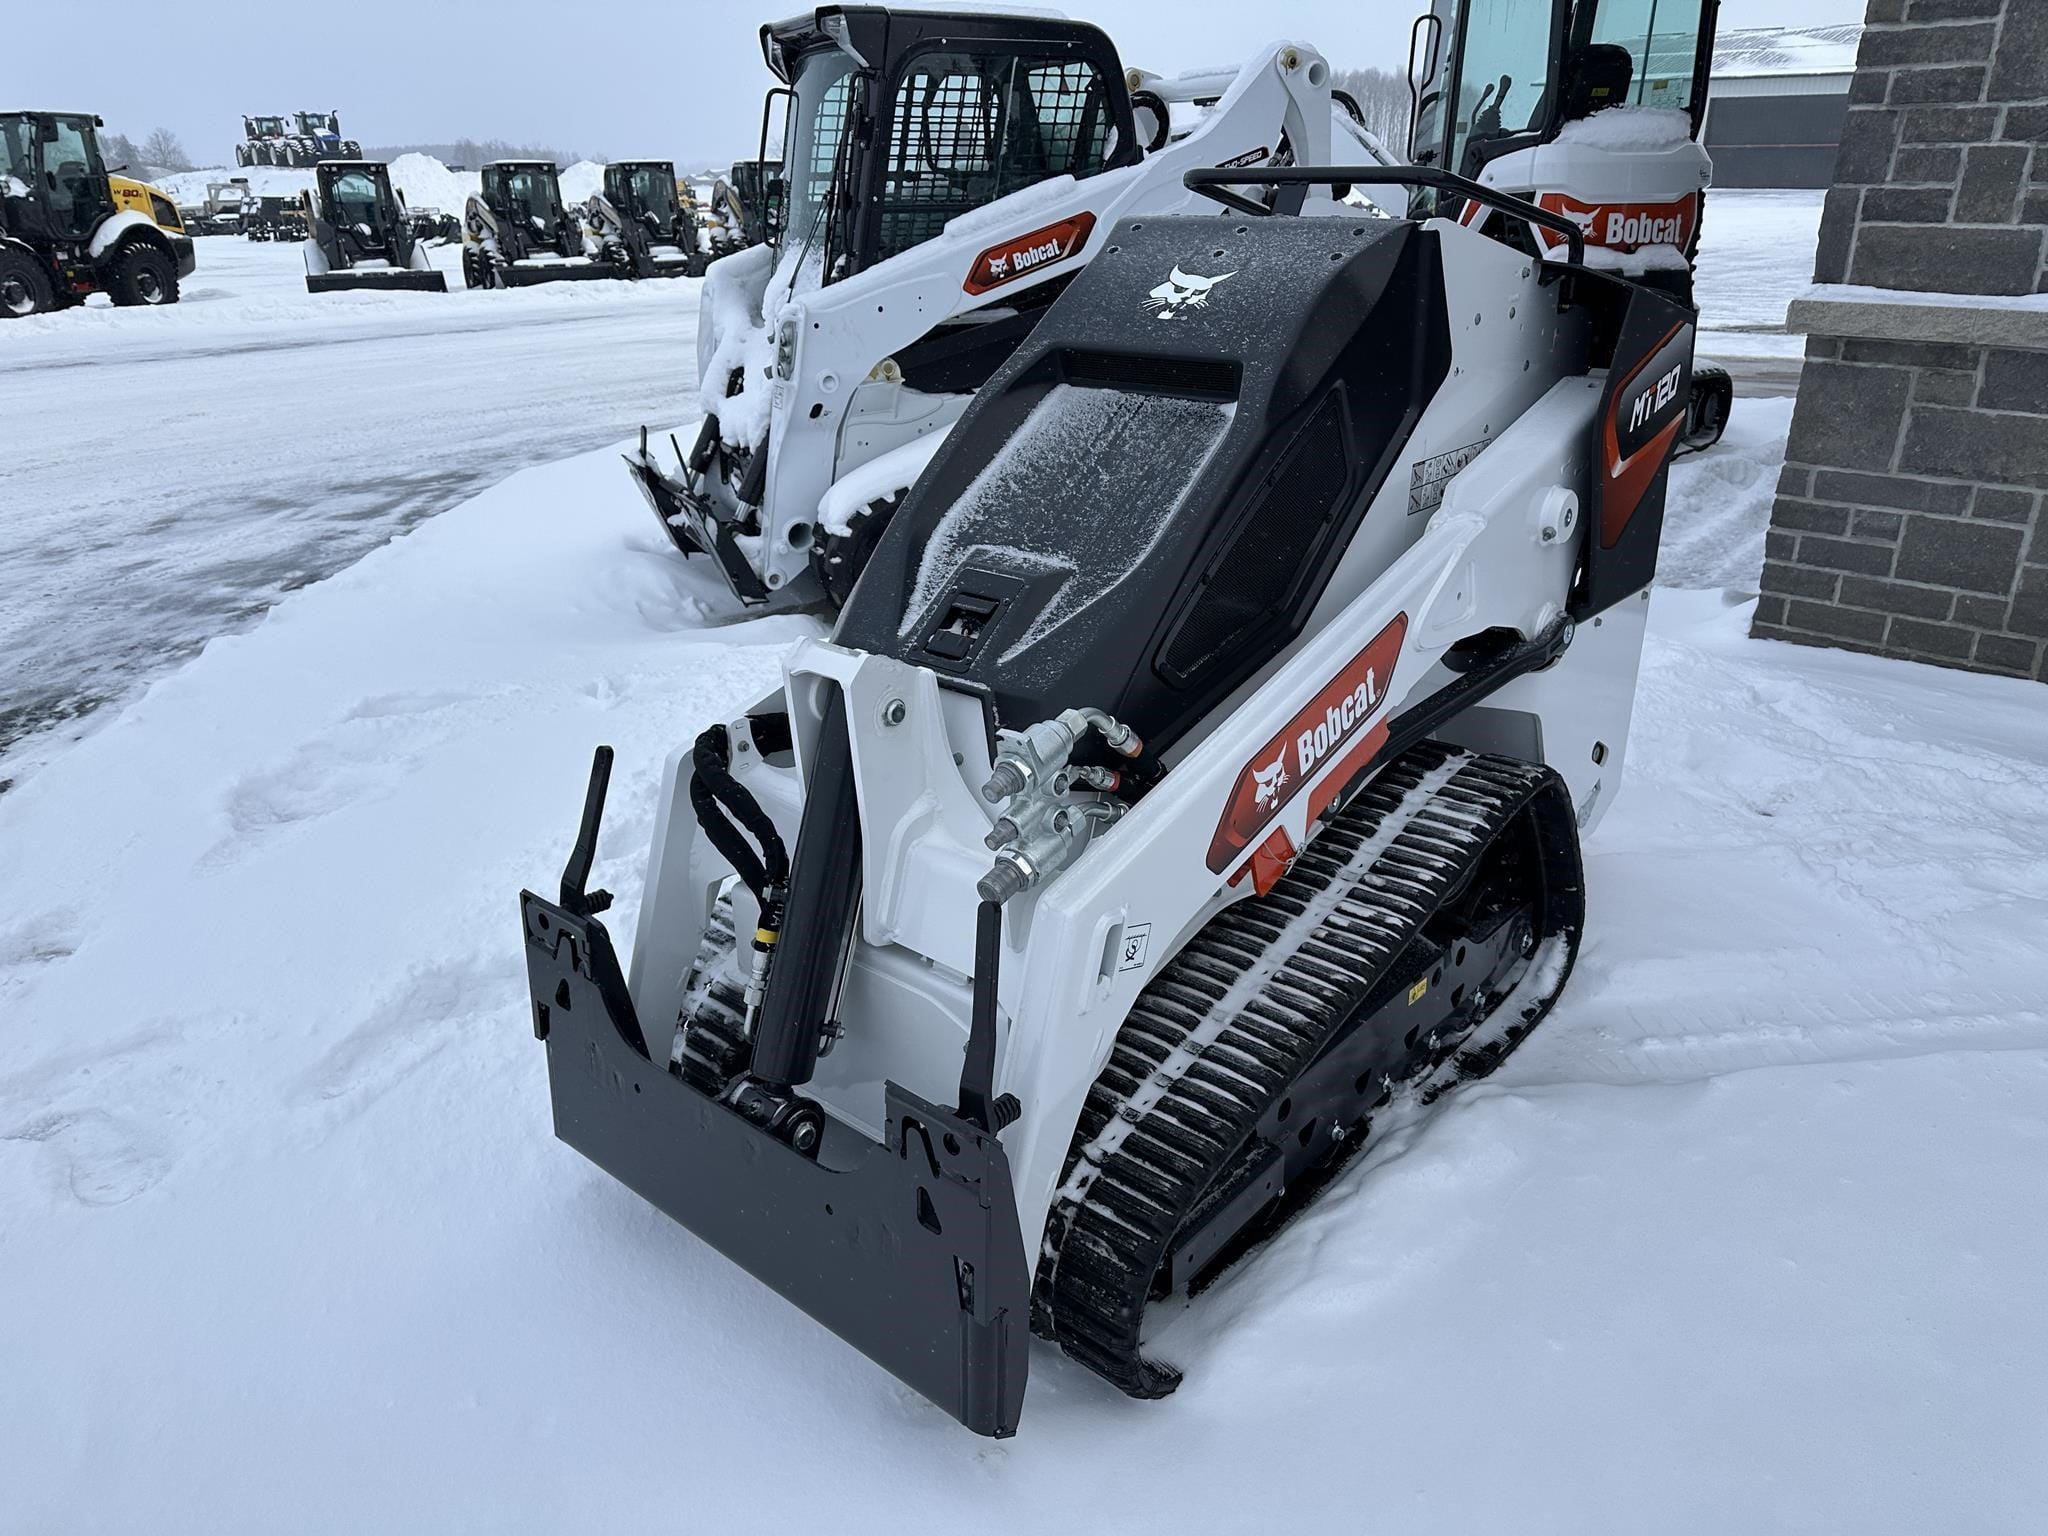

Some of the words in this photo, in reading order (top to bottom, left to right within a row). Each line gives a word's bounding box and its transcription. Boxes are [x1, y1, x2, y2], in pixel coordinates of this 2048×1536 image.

[1605, 212, 1682, 244] Bobcat
[1012, 238, 1061, 272] Bobcat
[1629, 363, 1682, 433] MT120
[1296, 666, 1377, 777] Bobcat
